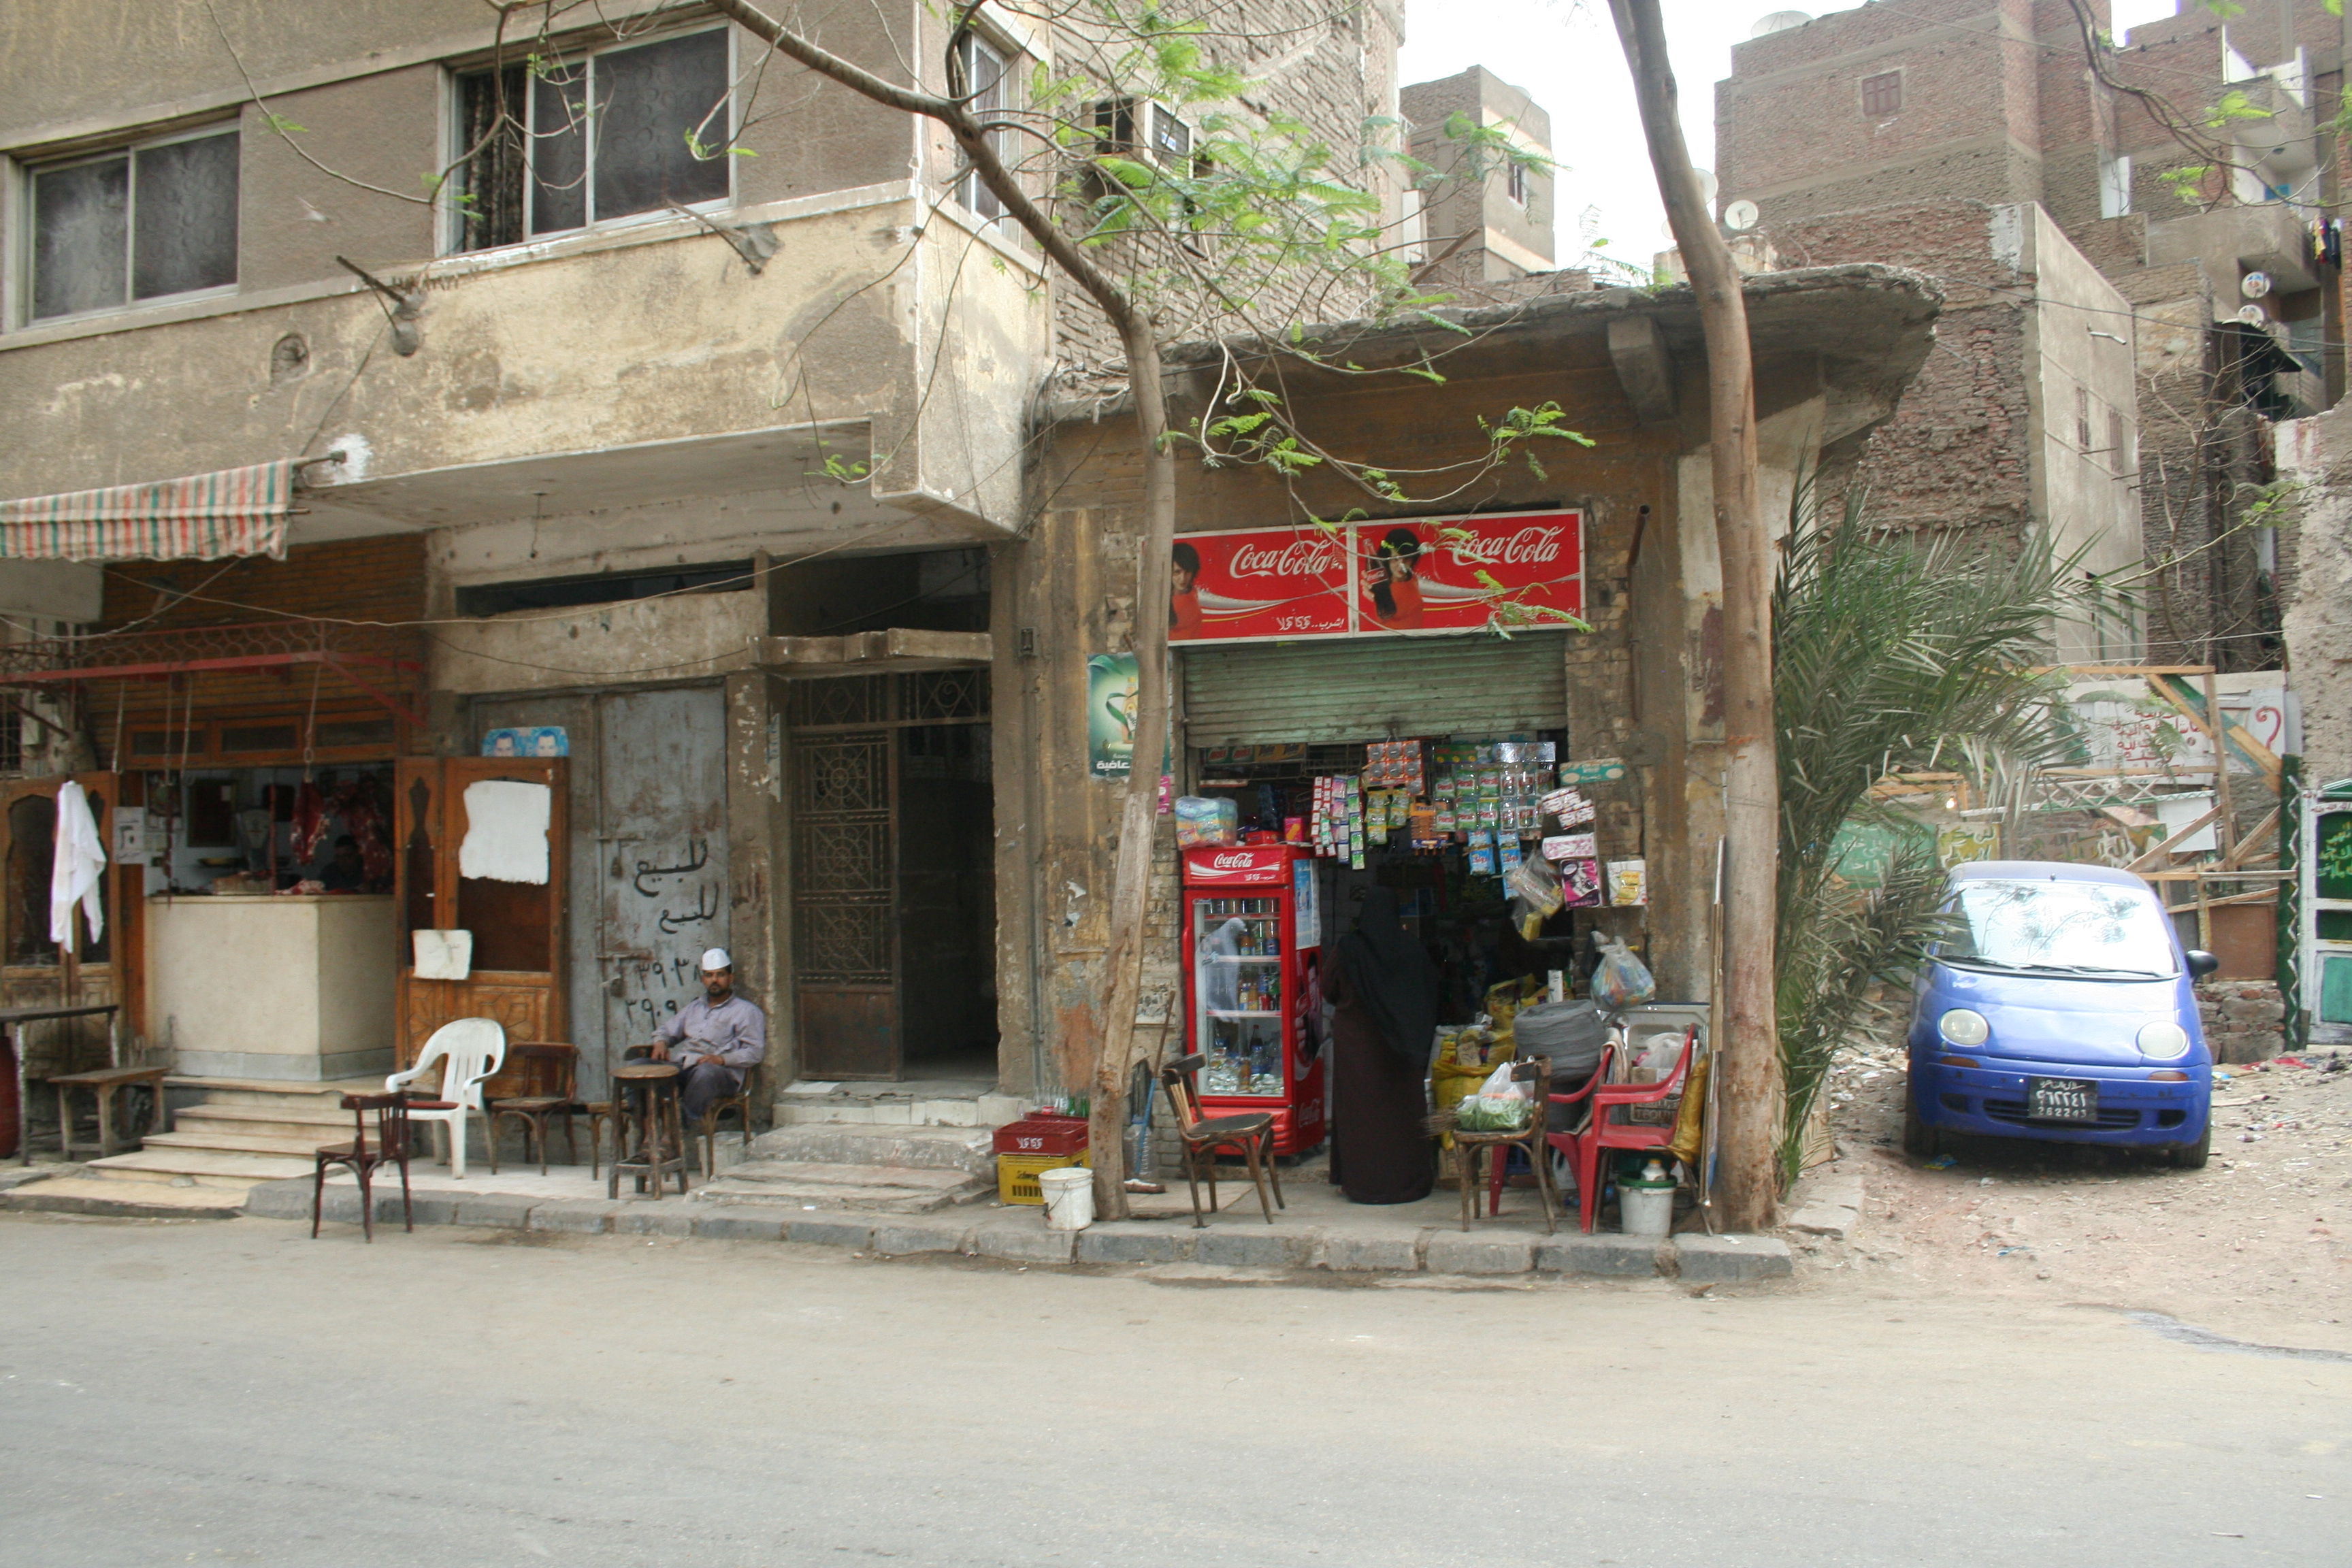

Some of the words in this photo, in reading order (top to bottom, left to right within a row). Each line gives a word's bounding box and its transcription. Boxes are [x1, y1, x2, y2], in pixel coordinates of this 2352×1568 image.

[1229, 539, 1333, 578] Coca-Cola
[1452, 525, 1565, 566] Coca-Cola
[1213, 853, 1255, 868] Coca-Cola
[659, 881, 719, 934] للبيع
